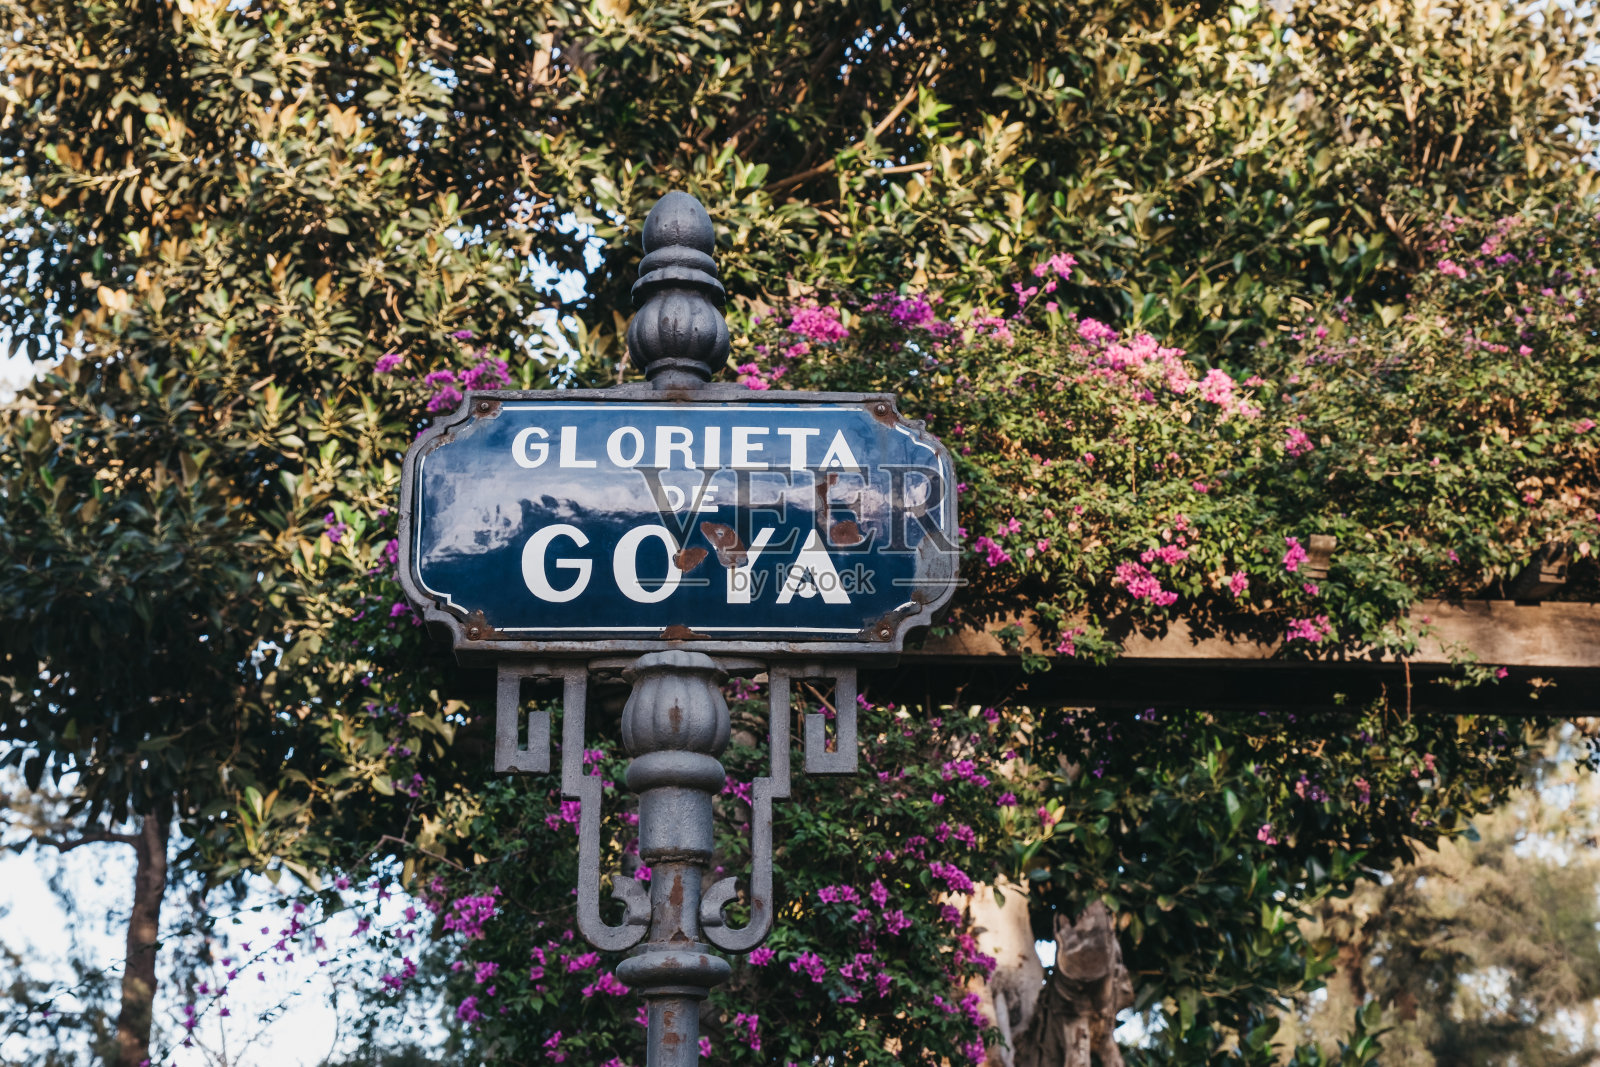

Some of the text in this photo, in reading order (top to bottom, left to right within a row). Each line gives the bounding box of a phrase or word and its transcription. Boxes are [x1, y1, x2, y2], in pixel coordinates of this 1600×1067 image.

[511, 425, 861, 473] GLORIETA
[658, 485, 719, 513] DE
[521, 523, 852, 605] GOYA
